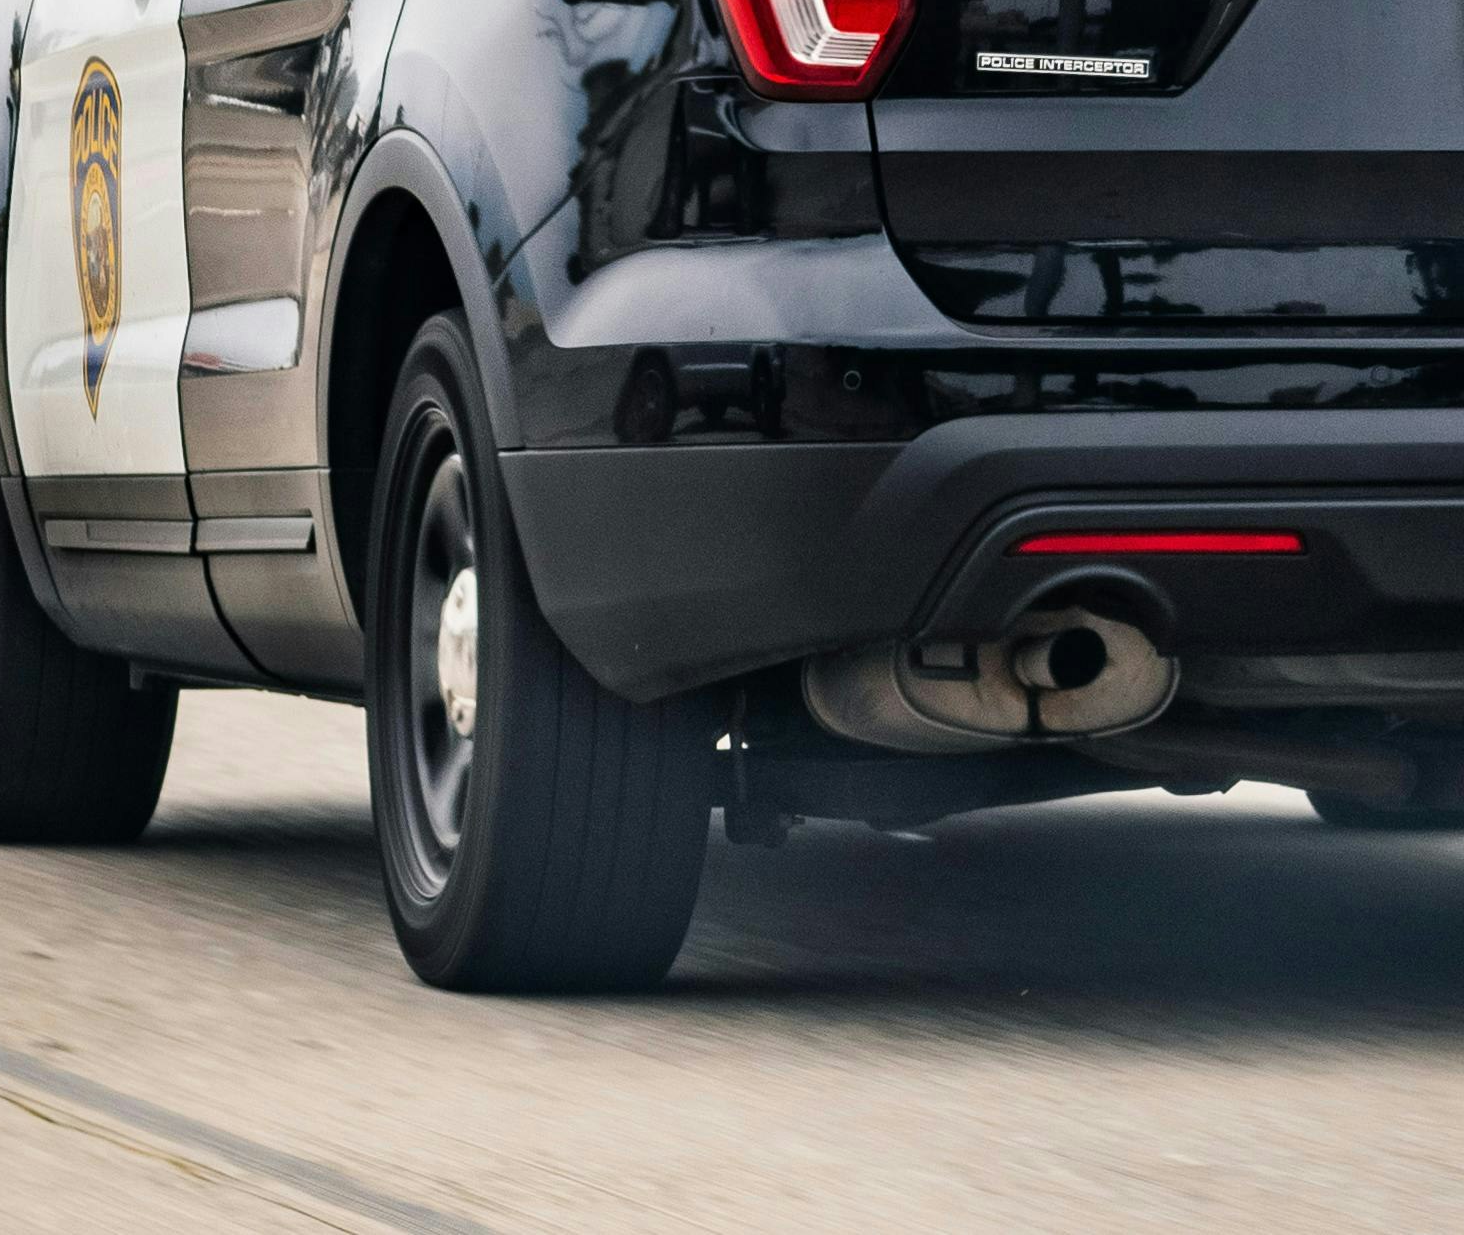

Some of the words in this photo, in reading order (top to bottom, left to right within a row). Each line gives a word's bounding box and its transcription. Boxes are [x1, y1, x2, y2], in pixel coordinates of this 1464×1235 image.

[980, 56, 1035, 70] POLICE
[1038, 57, 1145, 75] INTERCEPTOR
[73, 86, 120, 188] POLICE
